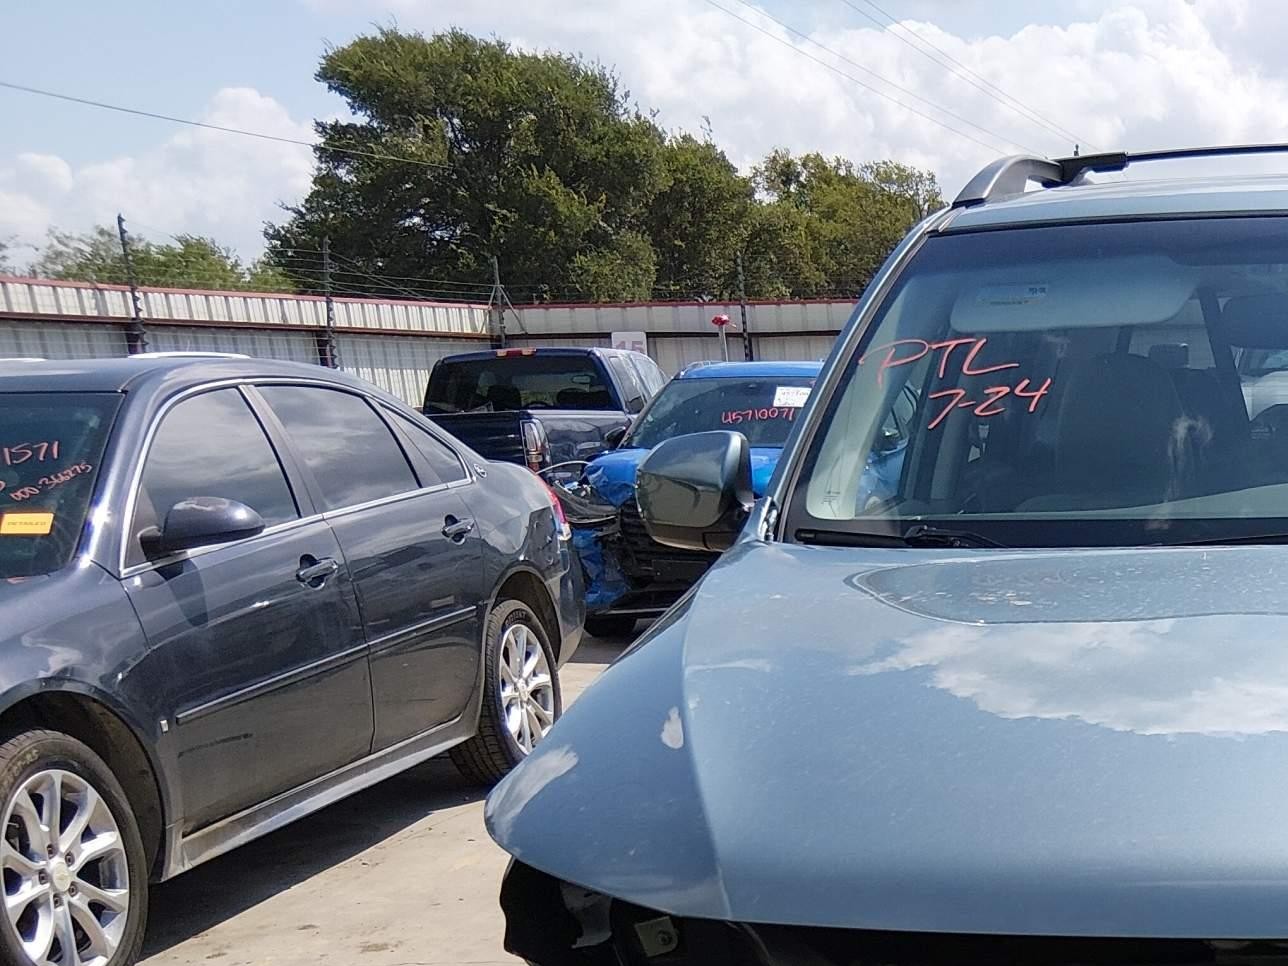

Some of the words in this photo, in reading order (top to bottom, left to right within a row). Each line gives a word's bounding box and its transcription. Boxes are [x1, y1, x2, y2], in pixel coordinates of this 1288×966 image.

[858, 337, 1020, 389] PTL
[721, 407, 795, 424] 45710071
[928, 377, 1052, 430] 7-24
[3, 441, 59, 465] 1571
